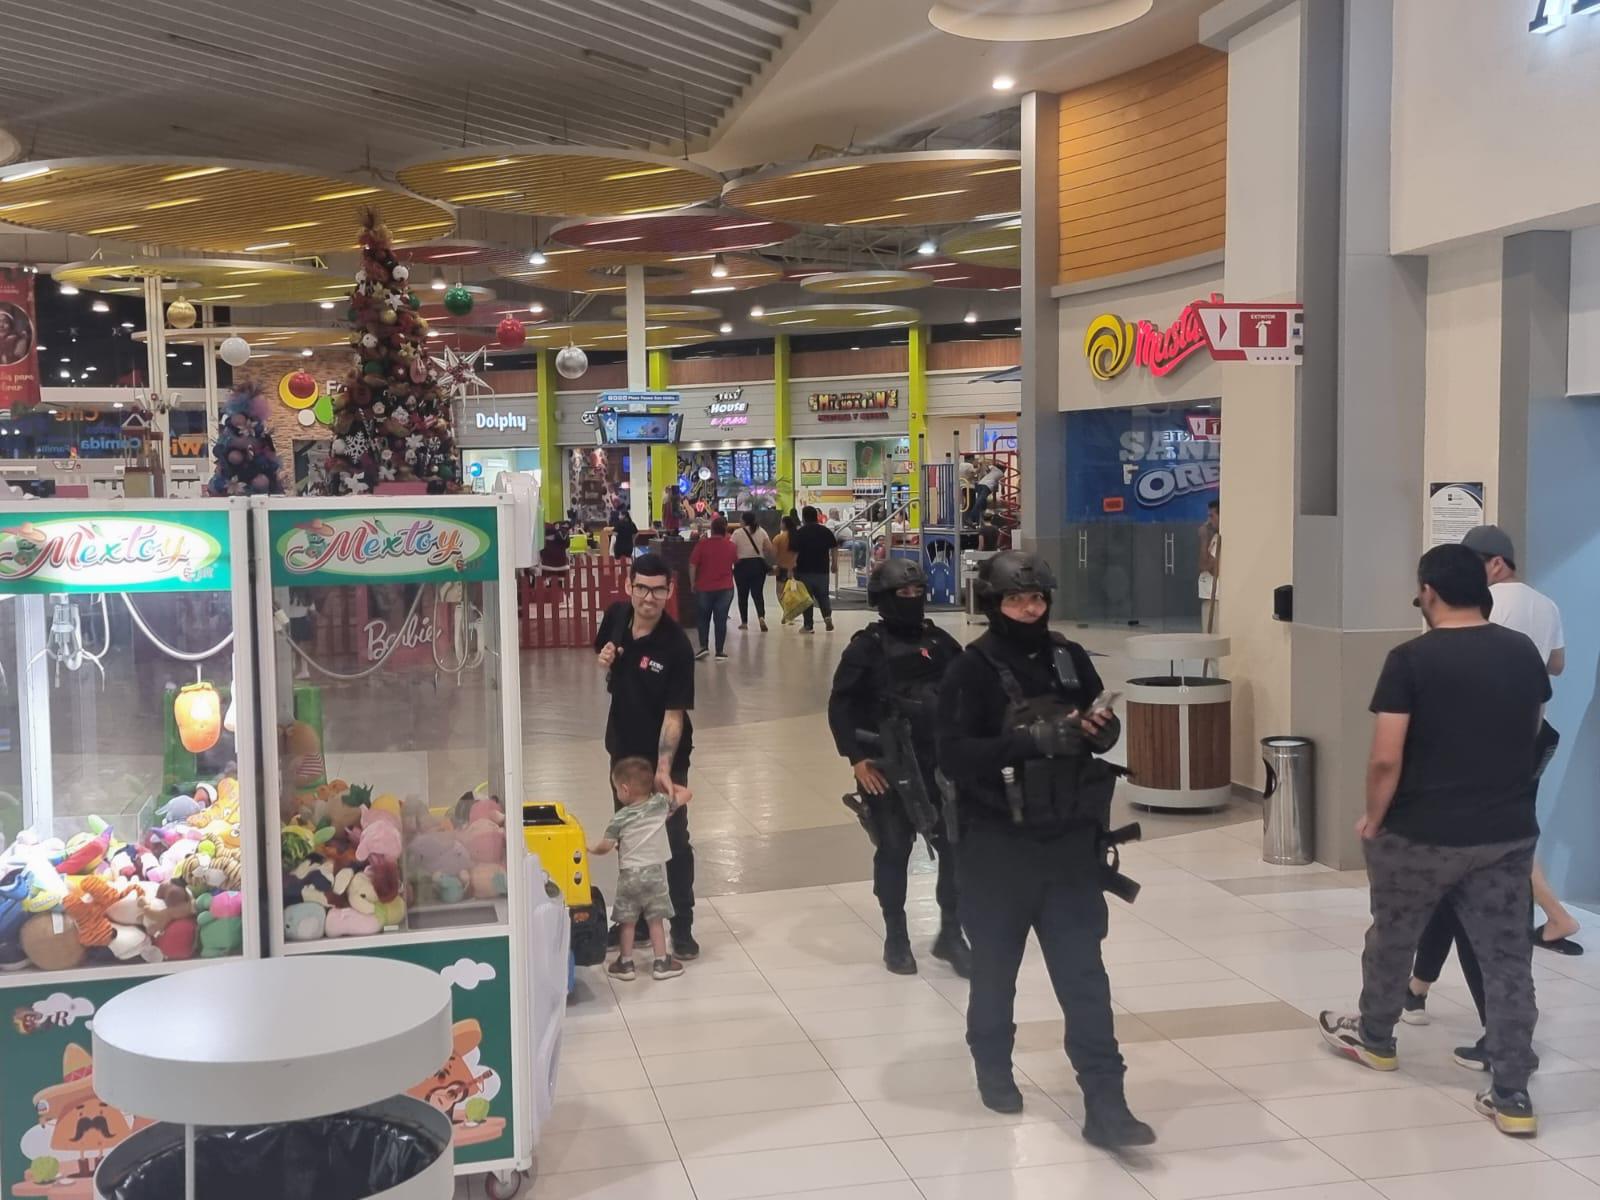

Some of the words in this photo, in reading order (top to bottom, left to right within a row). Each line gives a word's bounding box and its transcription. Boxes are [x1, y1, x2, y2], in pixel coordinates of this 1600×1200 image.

[476, 412, 527, 431] Dolphy
[710, 402, 746, 414] HOUSE
[1138, 462, 1220, 500] ORE
[0, 525, 188, 579] Mextoy
[285, 520, 464, 572] Mextoy
